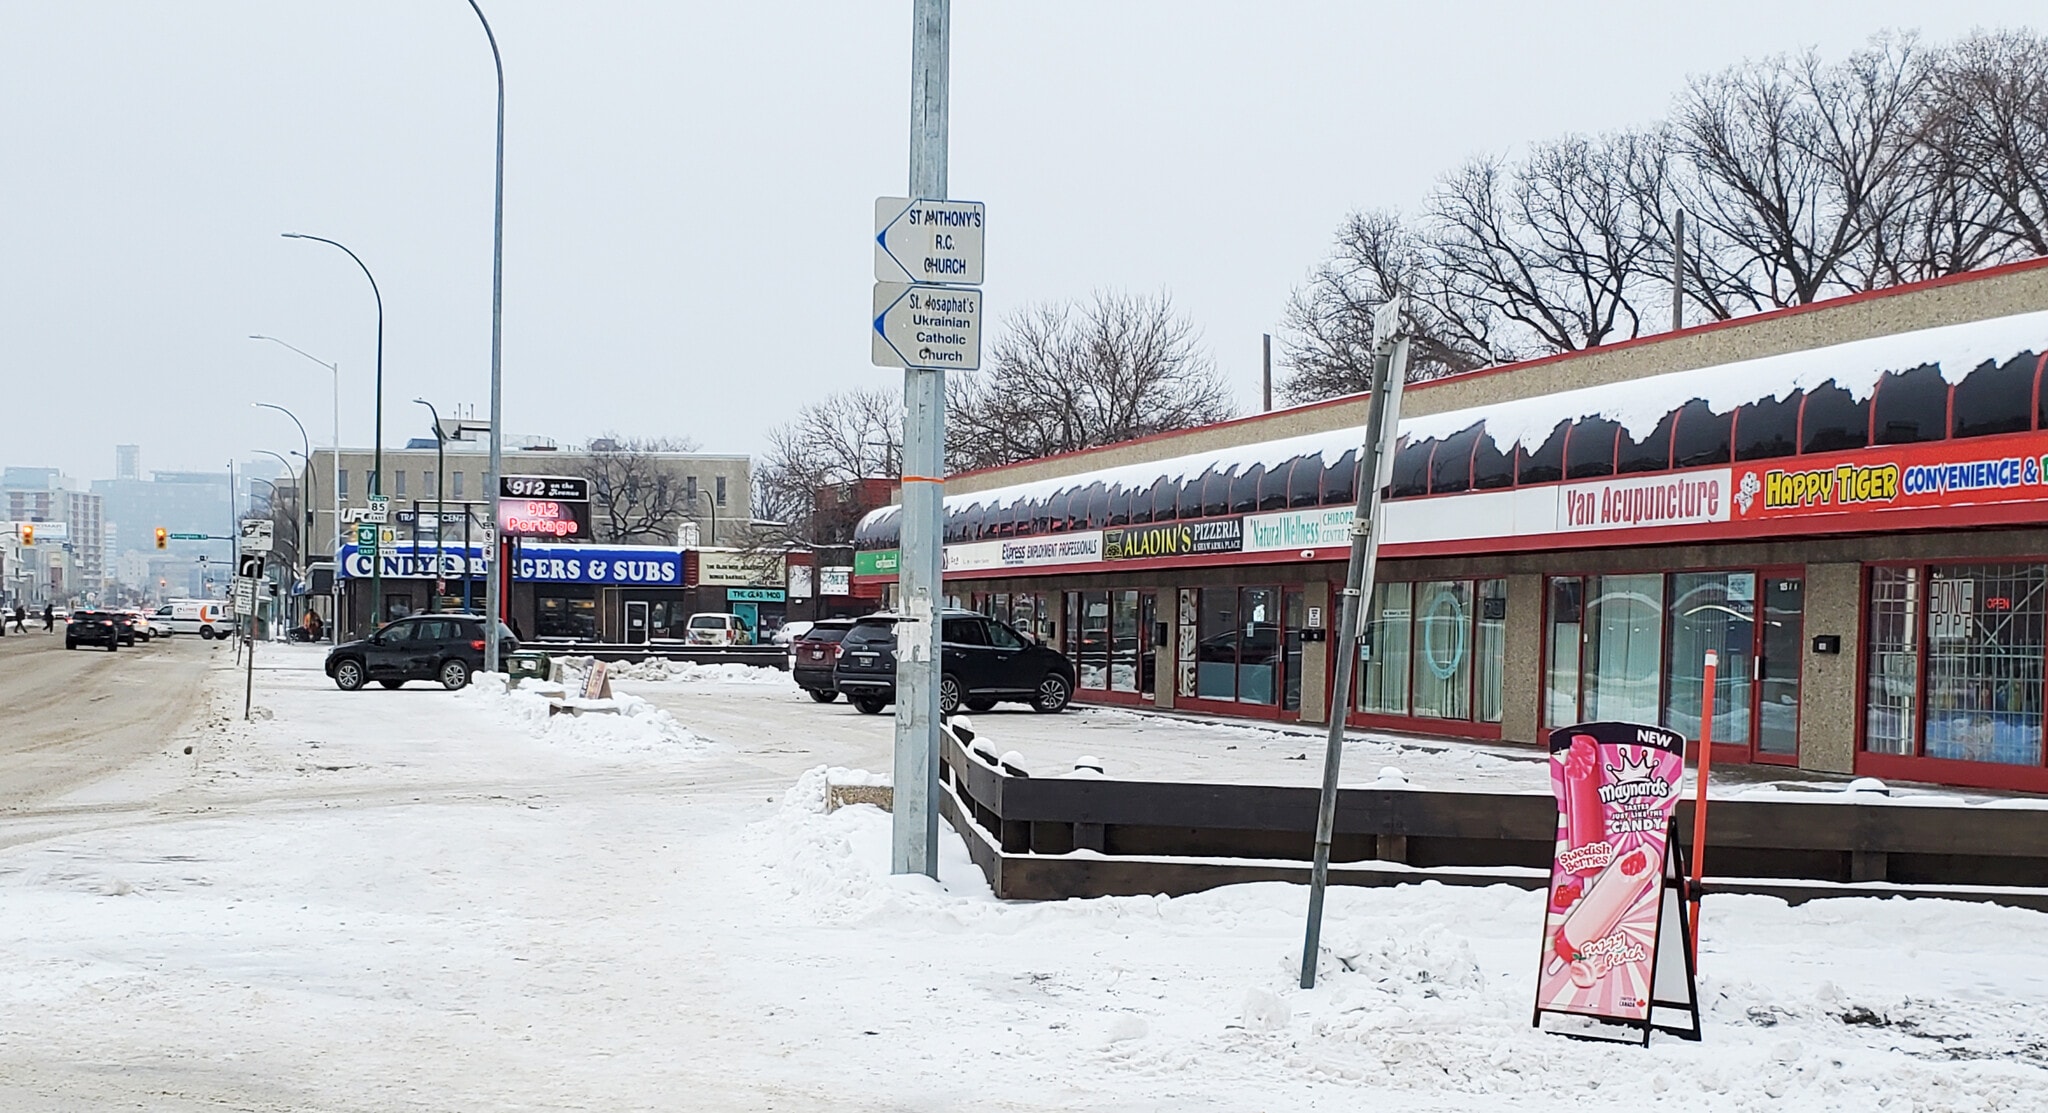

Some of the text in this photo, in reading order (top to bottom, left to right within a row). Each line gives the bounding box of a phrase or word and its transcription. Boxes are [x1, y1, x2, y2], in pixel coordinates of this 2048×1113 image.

[909, 209, 981, 228] ST ANTHONY'S
[935, 234, 955, 250] R.C.
[923, 257, 966, 274] CHURCH
[909, 293, 922, 310] St.
[912, 314, 971, 328] Ukrainian
[916, 331, 967, 345] Catholic
[918, 347, 963, 362] Church
[512, 481, 546, 496] 912
[1765, 470, 1834, 508] HAPPY
[1836, 464, 1898, 503] TIGER
[1904, 460, 2020, 494] CONVENIENCE
[2023, 458, 2038, 484] &
[371, 502, 385, 512] 85
[527, 501, 559, 518] 912
[1567, 478, 1719, 526] Yan Acupuncture
[507, 516, 578, 537] Portage
[1193, 520, 1241, 541] PIZZERIA
[1253, 515, 1319, 548] Natural Wellness
[1002, 543, 1025, 560] Express
[1058, 539, 1098, 557] PROFESSIONALS
[1124, 524, 1192, 557] ALADIN'S
[588, 560, 606, 580] &
[613, 561, 676, 581] SUBS
[1986, 598, 2010, 610] OPEN
[1934, 614, 1972, 638] PIPE
[1636, 729, 1673, 747] NEW
[1612, 812, 1629, 820] JUST
[1650, 809, 1663, 817] THE
[1624, 803, 1650, 811] TASTES
[1611, 817, 1663, 833] CANDY
[1560, 844, 1611, 864] Swedish
[1565, 855, 1609, 873] Berries
[1581, 931, 1626, 956] Fuzzy
[1605, 943, 1645, 971] Peach
